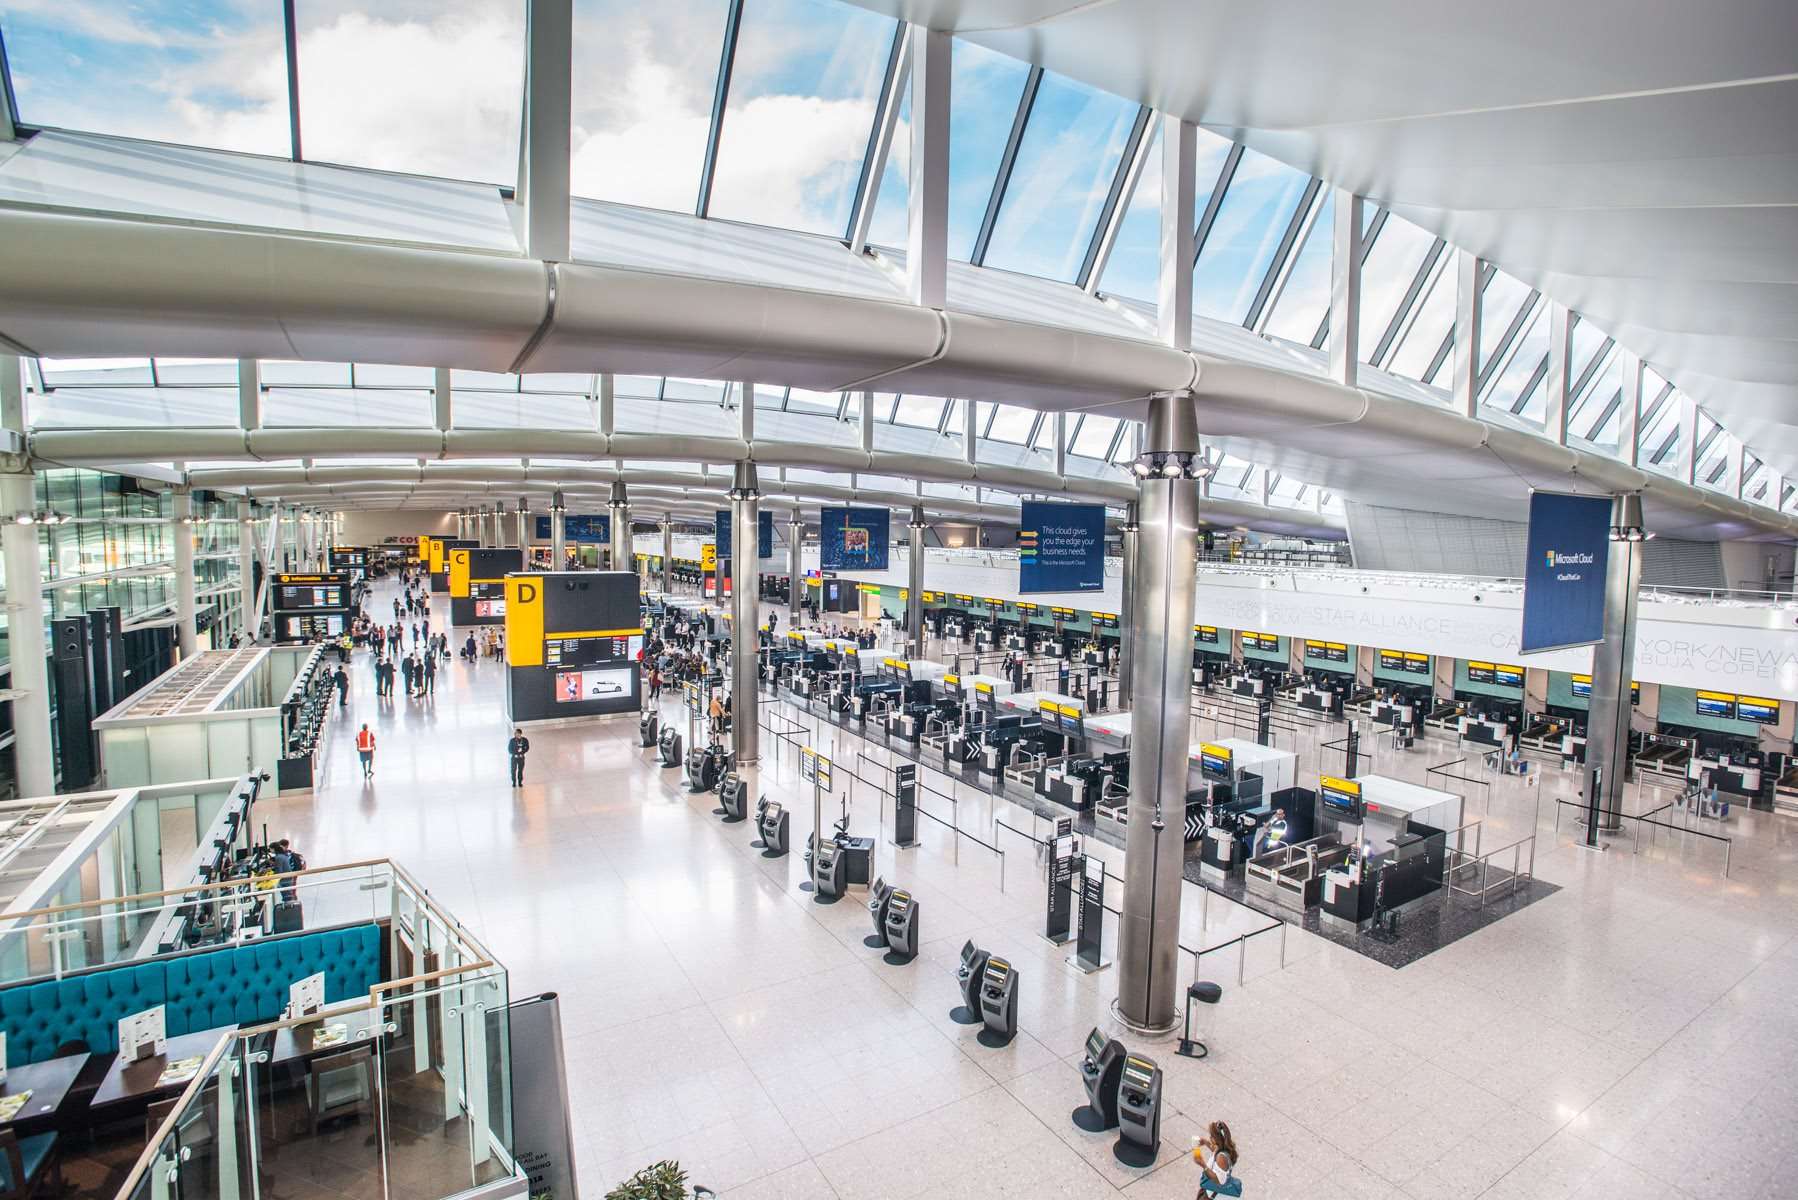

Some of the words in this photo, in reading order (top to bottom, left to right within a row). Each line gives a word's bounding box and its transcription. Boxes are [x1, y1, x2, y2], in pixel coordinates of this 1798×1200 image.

[1055, 526, 1072, 535] cloud
[433, 543, 440, 551] B
[1066, 538, 1081, 547] edge
[1082, 539, 1095, 548] your
[1042, 547, 1067, 555] business
[456, 553, 465, 564] C
[1556, 551, 1579, 564] Microsoft
[1579, 552, 1593, 564] Cloud
[518, 583, 536, 604] D
[1359, 611, 1450, 635] ALLIANCE
